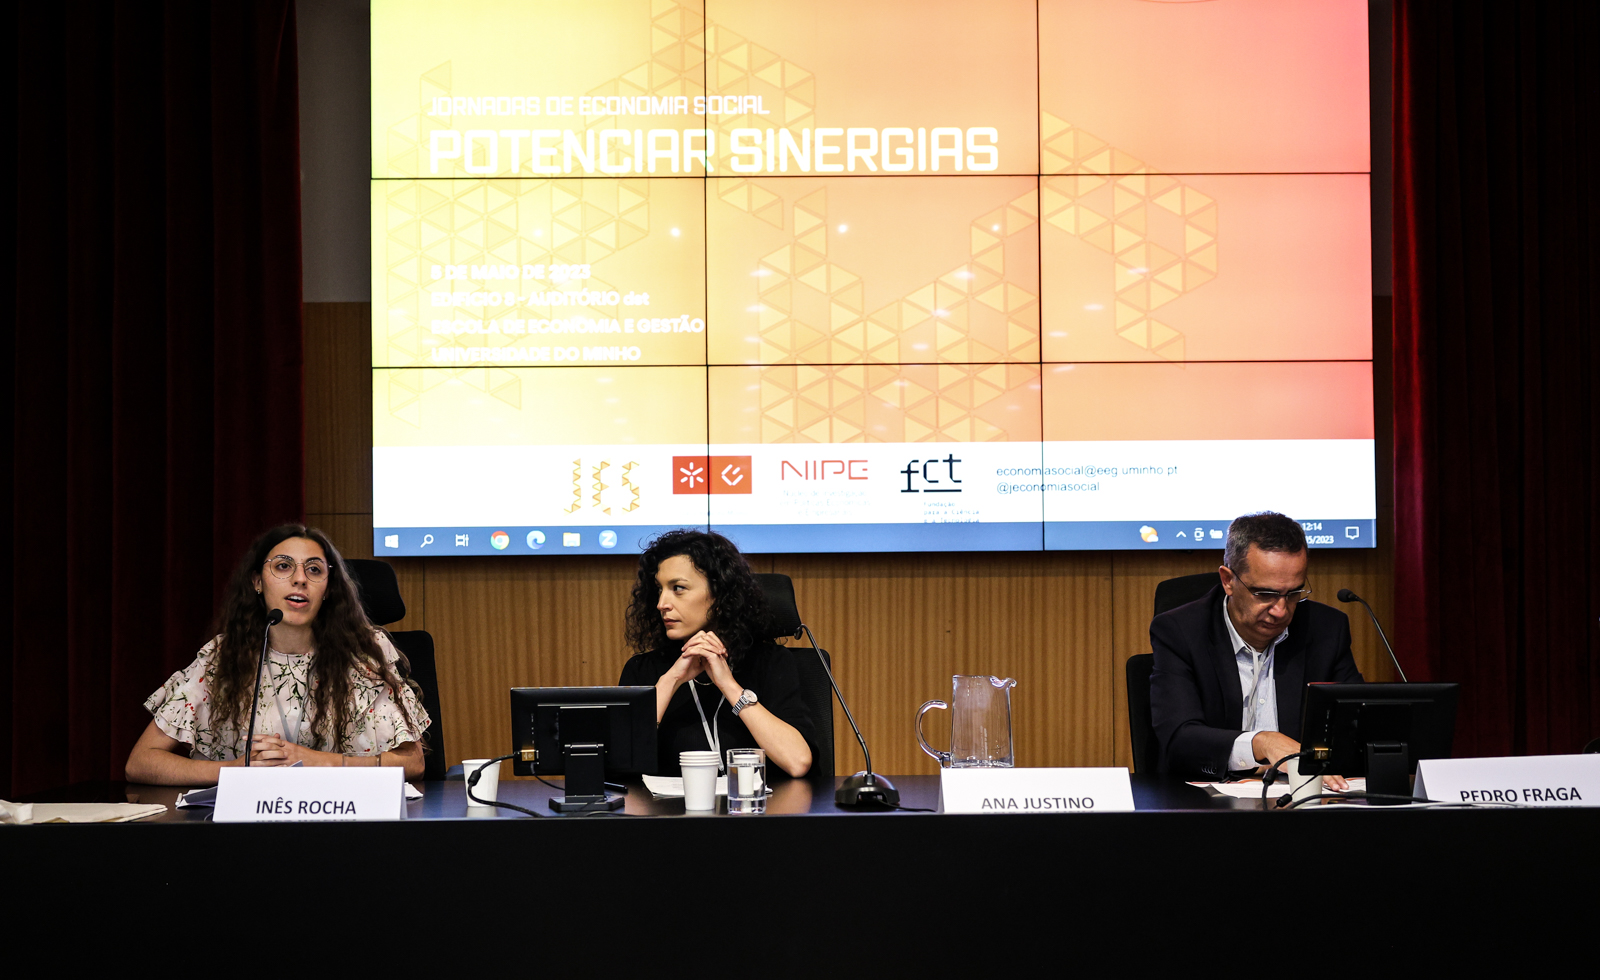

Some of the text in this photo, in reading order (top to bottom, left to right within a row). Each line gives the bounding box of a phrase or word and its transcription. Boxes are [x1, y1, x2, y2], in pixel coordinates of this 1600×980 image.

[428, 95, 770, 116] JORNADAS DE ECONOMIA SOCIAL
[429, 126, 999, 174] POTENCIAR SINERGIAS
[445, 264, 467, 280] DE
[471, 264, 520, 280] MAIO
[522, 264, 545, 280] DE
[549, 264, 591, 280] 2023
[527, 288, 620, 306] AUDITÓRIO
[623, 291, 650, 306] dst
[431, 314, 705, 334] ESCOLA DE ECONOMIA E GESTÃO
[431, 346, 641, 362] UNIVERSIDADE DO MINHO
[781, 460, 869, 480] NIPE
[900, 453, 963, 493] fct
[1302, 522, 1322, 531] 12:14
[981, 796, 1095, 809] ANA JUSTINO
[1460, 786, 1582, 803] PEDRO FRAGA
[256, 796, 357, 815] INÊS ROCHA
